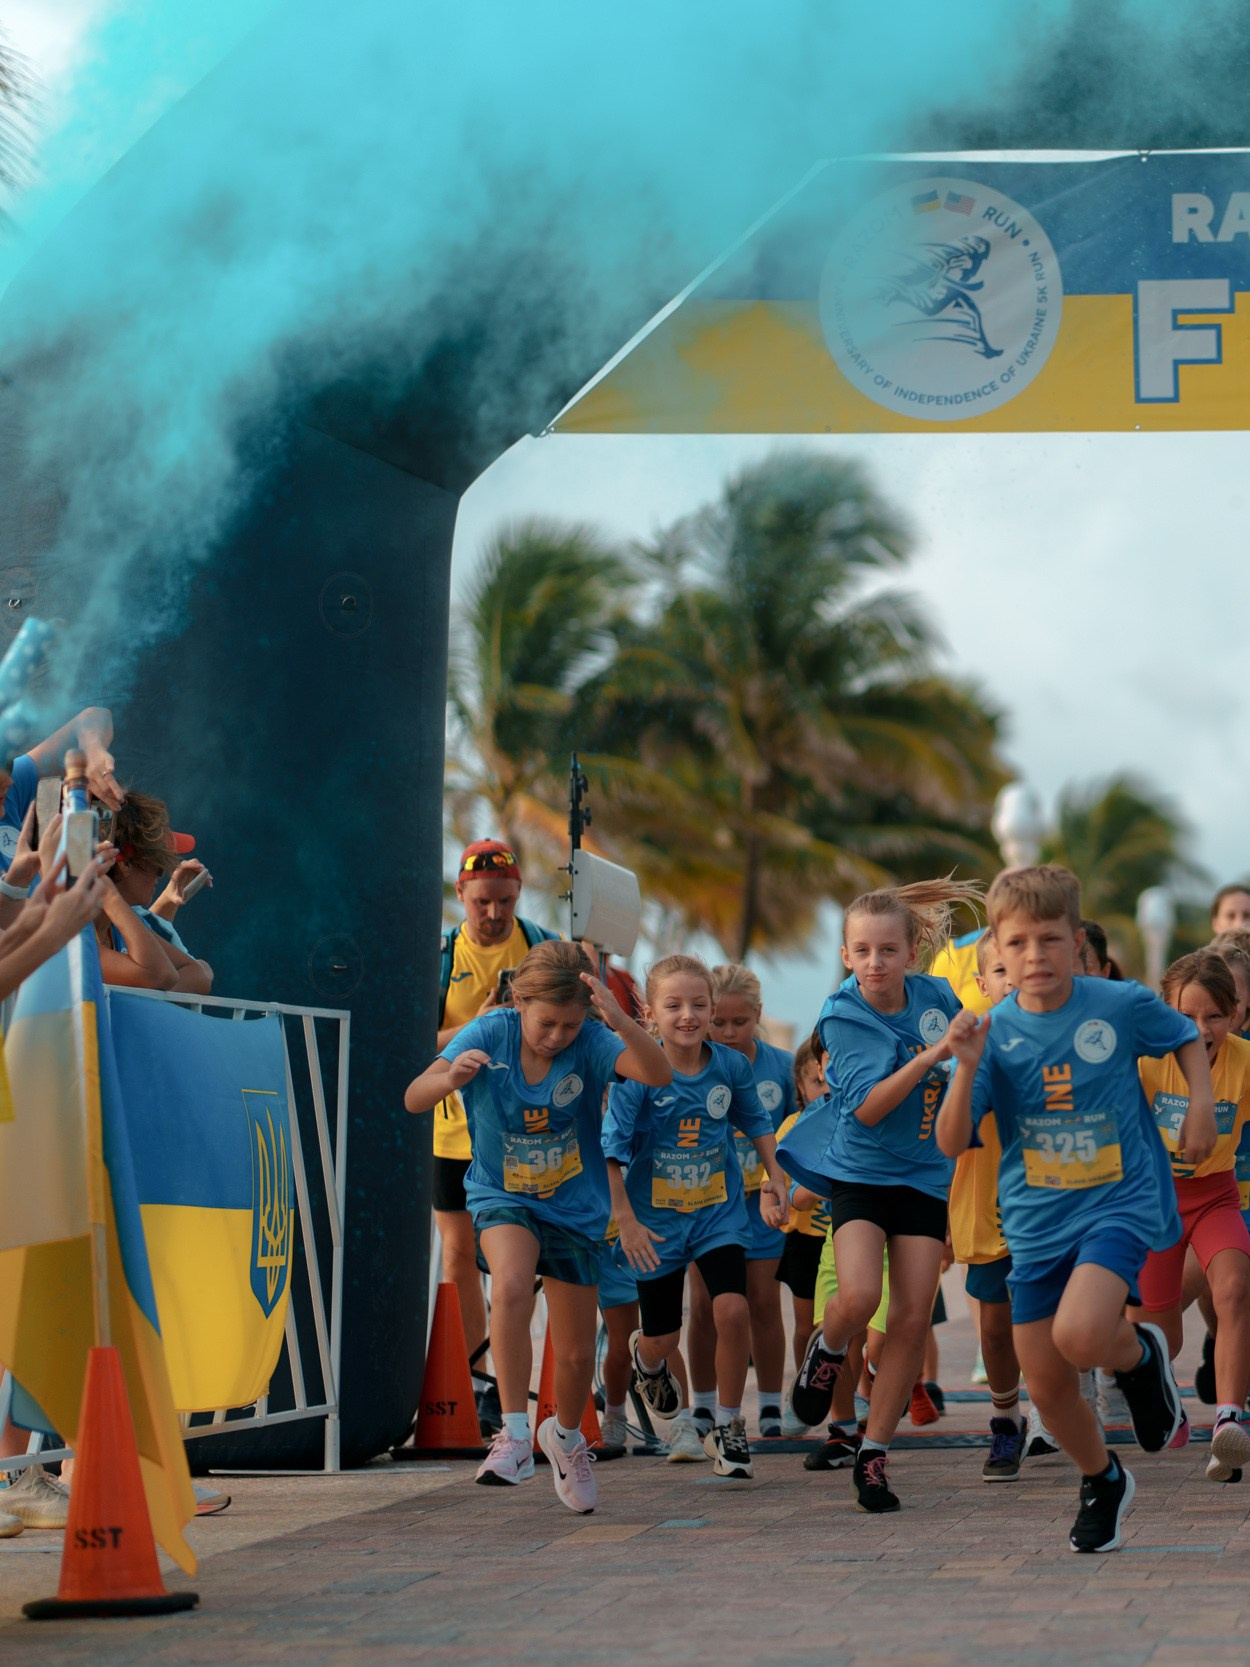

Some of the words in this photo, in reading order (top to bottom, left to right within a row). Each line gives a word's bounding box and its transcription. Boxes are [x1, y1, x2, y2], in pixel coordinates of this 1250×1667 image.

[982, 206, 1023, 239] RUN
[1028, 251, 1046, 281] RUN
[1036, 285, 1048, 304] 5K
[1015, 309, 1047, 367] UKRAINE
[873, 374, 893, 390] OF
[1000, 365, 1017, 384] OF
[893, 380, 999, 406] INDEPENDENCE
[1083, 1112, 1106, 1123] RUN
[510, 1136, 541, 1145] RAZOM
[706, 1147, 719, 1156] RUN
[1036, 1130, 1097, 1163] 325
[528, 1147, 563, 1174] 36
[666, 1162, 711, 1190] 332
[425, 1401, 457, 1416] SST
[74, 1527, 122, 1549] SST
